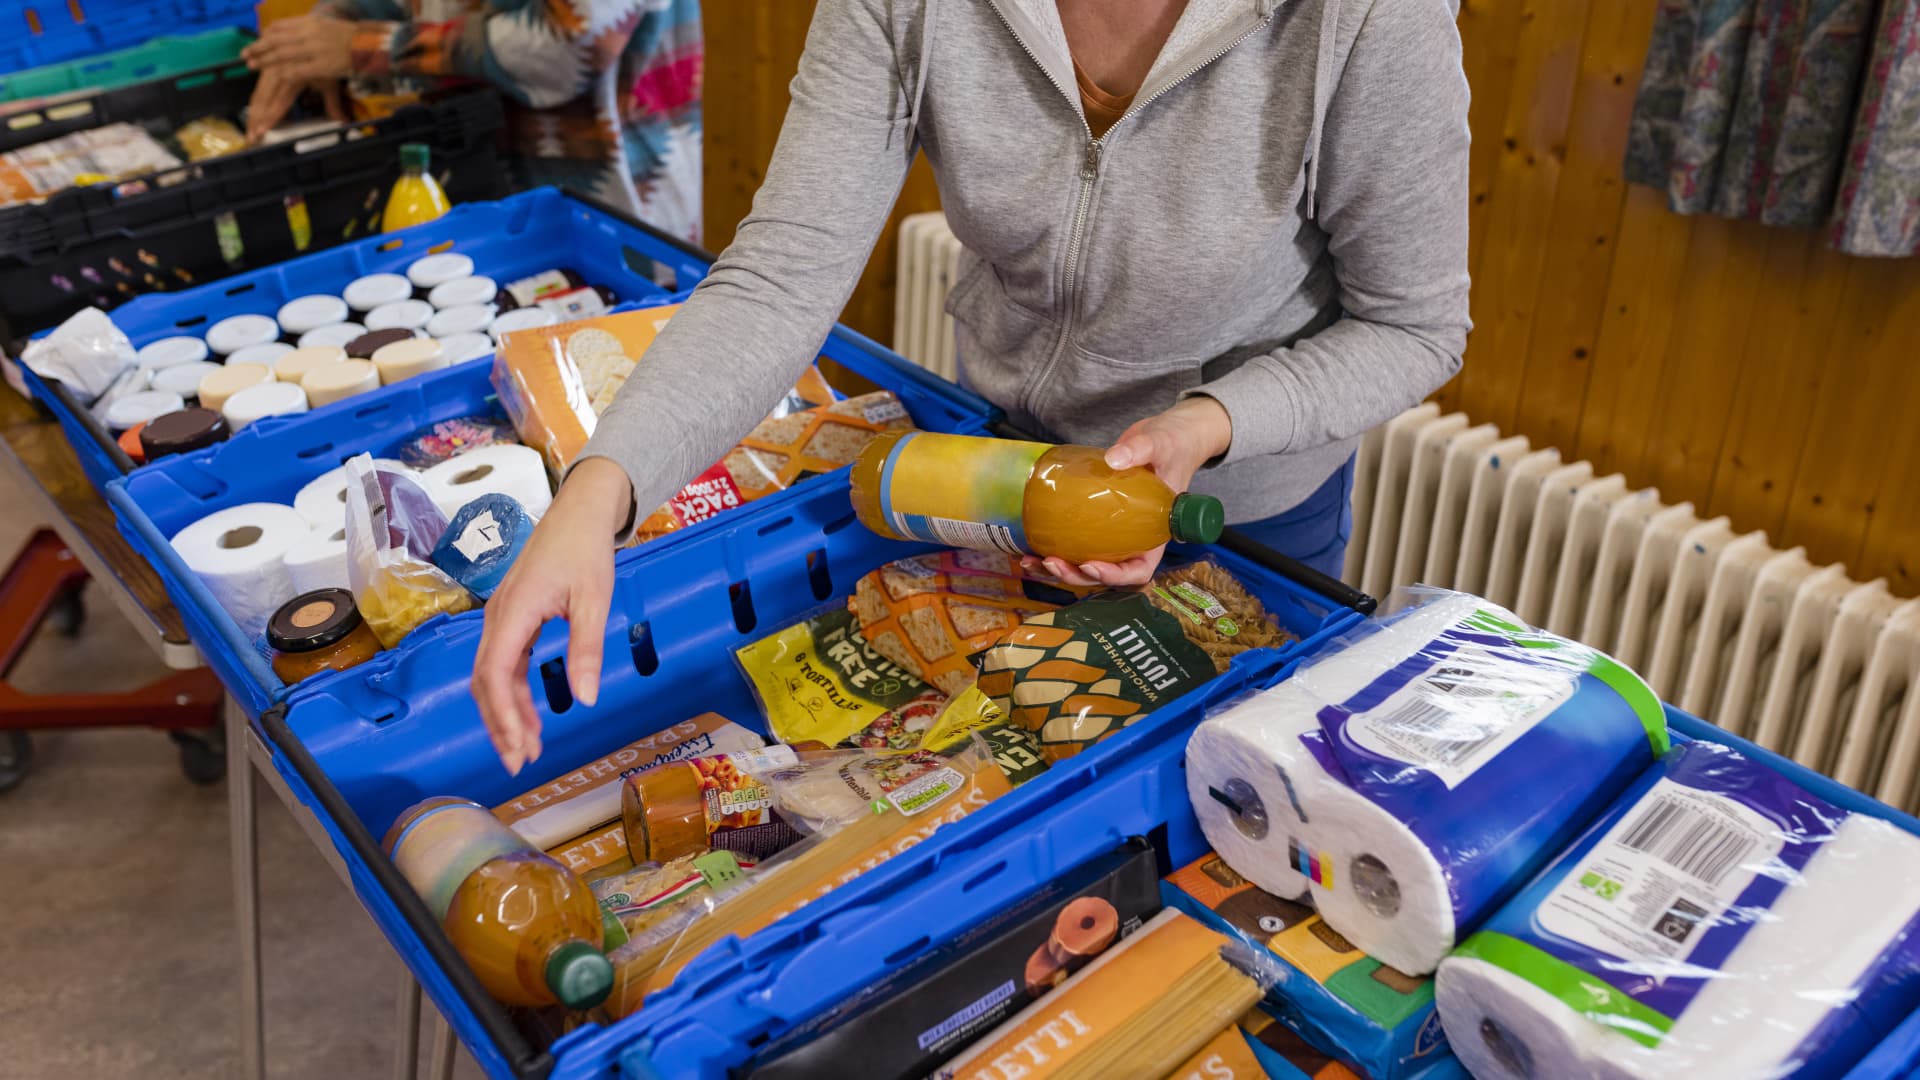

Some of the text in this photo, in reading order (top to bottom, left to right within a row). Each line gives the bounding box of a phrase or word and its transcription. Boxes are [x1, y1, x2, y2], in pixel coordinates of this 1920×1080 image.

[675, 489, 739, 520] PACK
[800, 662, 864, 711] TORTILLAS
[823, 626, 880, 689] FREE
[1091, 631, 1159, 702] WHOLEWHEAT
[1108, 624, 1179, 691] FUSILLI
[510, 719, 698, 813] SPAGHETTI
